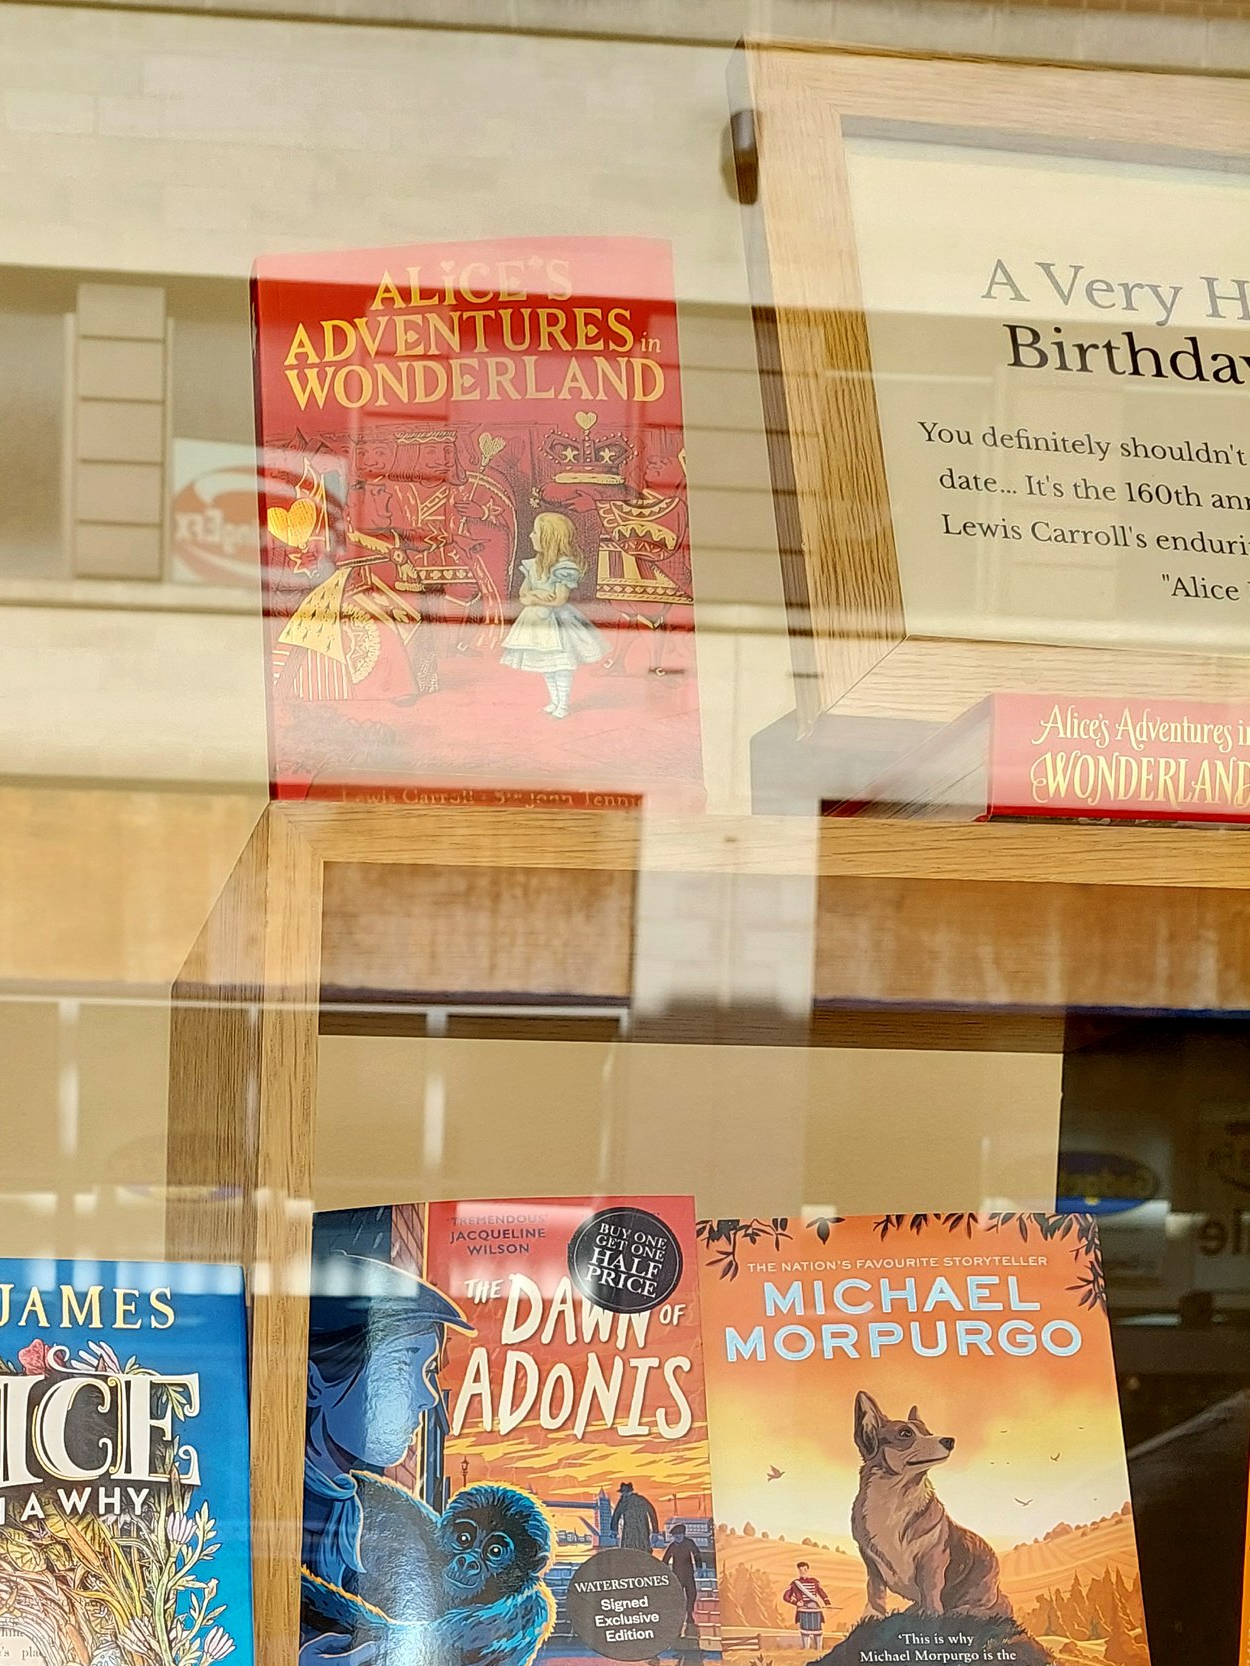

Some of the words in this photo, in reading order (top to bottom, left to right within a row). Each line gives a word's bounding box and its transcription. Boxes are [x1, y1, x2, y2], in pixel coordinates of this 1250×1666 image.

[981, 259, 1030, 302] A
[1036, 261, 1183, 326] Very
[283, 309, 635, 366] ADVENTURES
[641, 332, 661, 354] in
[285, 356, 665, 410] WONDERLAND
[918, 421, 973, 446] You
[981, 426, 1111, 461] definitely
[1120, 434, 1247, 466] shouldn't
[939, 469, 1018, 495] date...
[1025, 475, 1064, 499] It's
[1072, 477, 1116, 502] the
[1125, 481, 1201, 507] 160th
[942, 514, 1023, 541] Lewis
[1031, 521, 1147, 549] Carroll's
[1032, 705, 1111, 748] Alice's
[1115, 709, 1233, 752] Adventures
[451, 1227, 546, 1243] JACQUELINE
[467, 1241, 530, 1255] WILSON
[748, 1262, 776, 1273] THE
[781, 1260, 851, 1272] NATION'S
[856, 1258, 938, 1270] FAVOURITE
[943, 1257, 1047, 1268] STORYTELLER
[465, 1278, 501, 1303] THE
[501, 1273, 649, 1350] DAWN
[660, 1304, 687, 1326] OF
[763, 1275, 1041, 1317] MICHAEL
[725, 1320, 1082, 1362] MORPURGO
[452, 1347, 692, 1439] ADONIS
[21, 1497, 45, 1522] A
[58, 1486, 151, 1517] WHY
[575, 1575, 669, 1593] WATERSTONES
[595, 1611, 659, 1626] Exclusive
[601, 1596, 649, 1612] Signed
[605, 1628, 654, 1642] Edition
